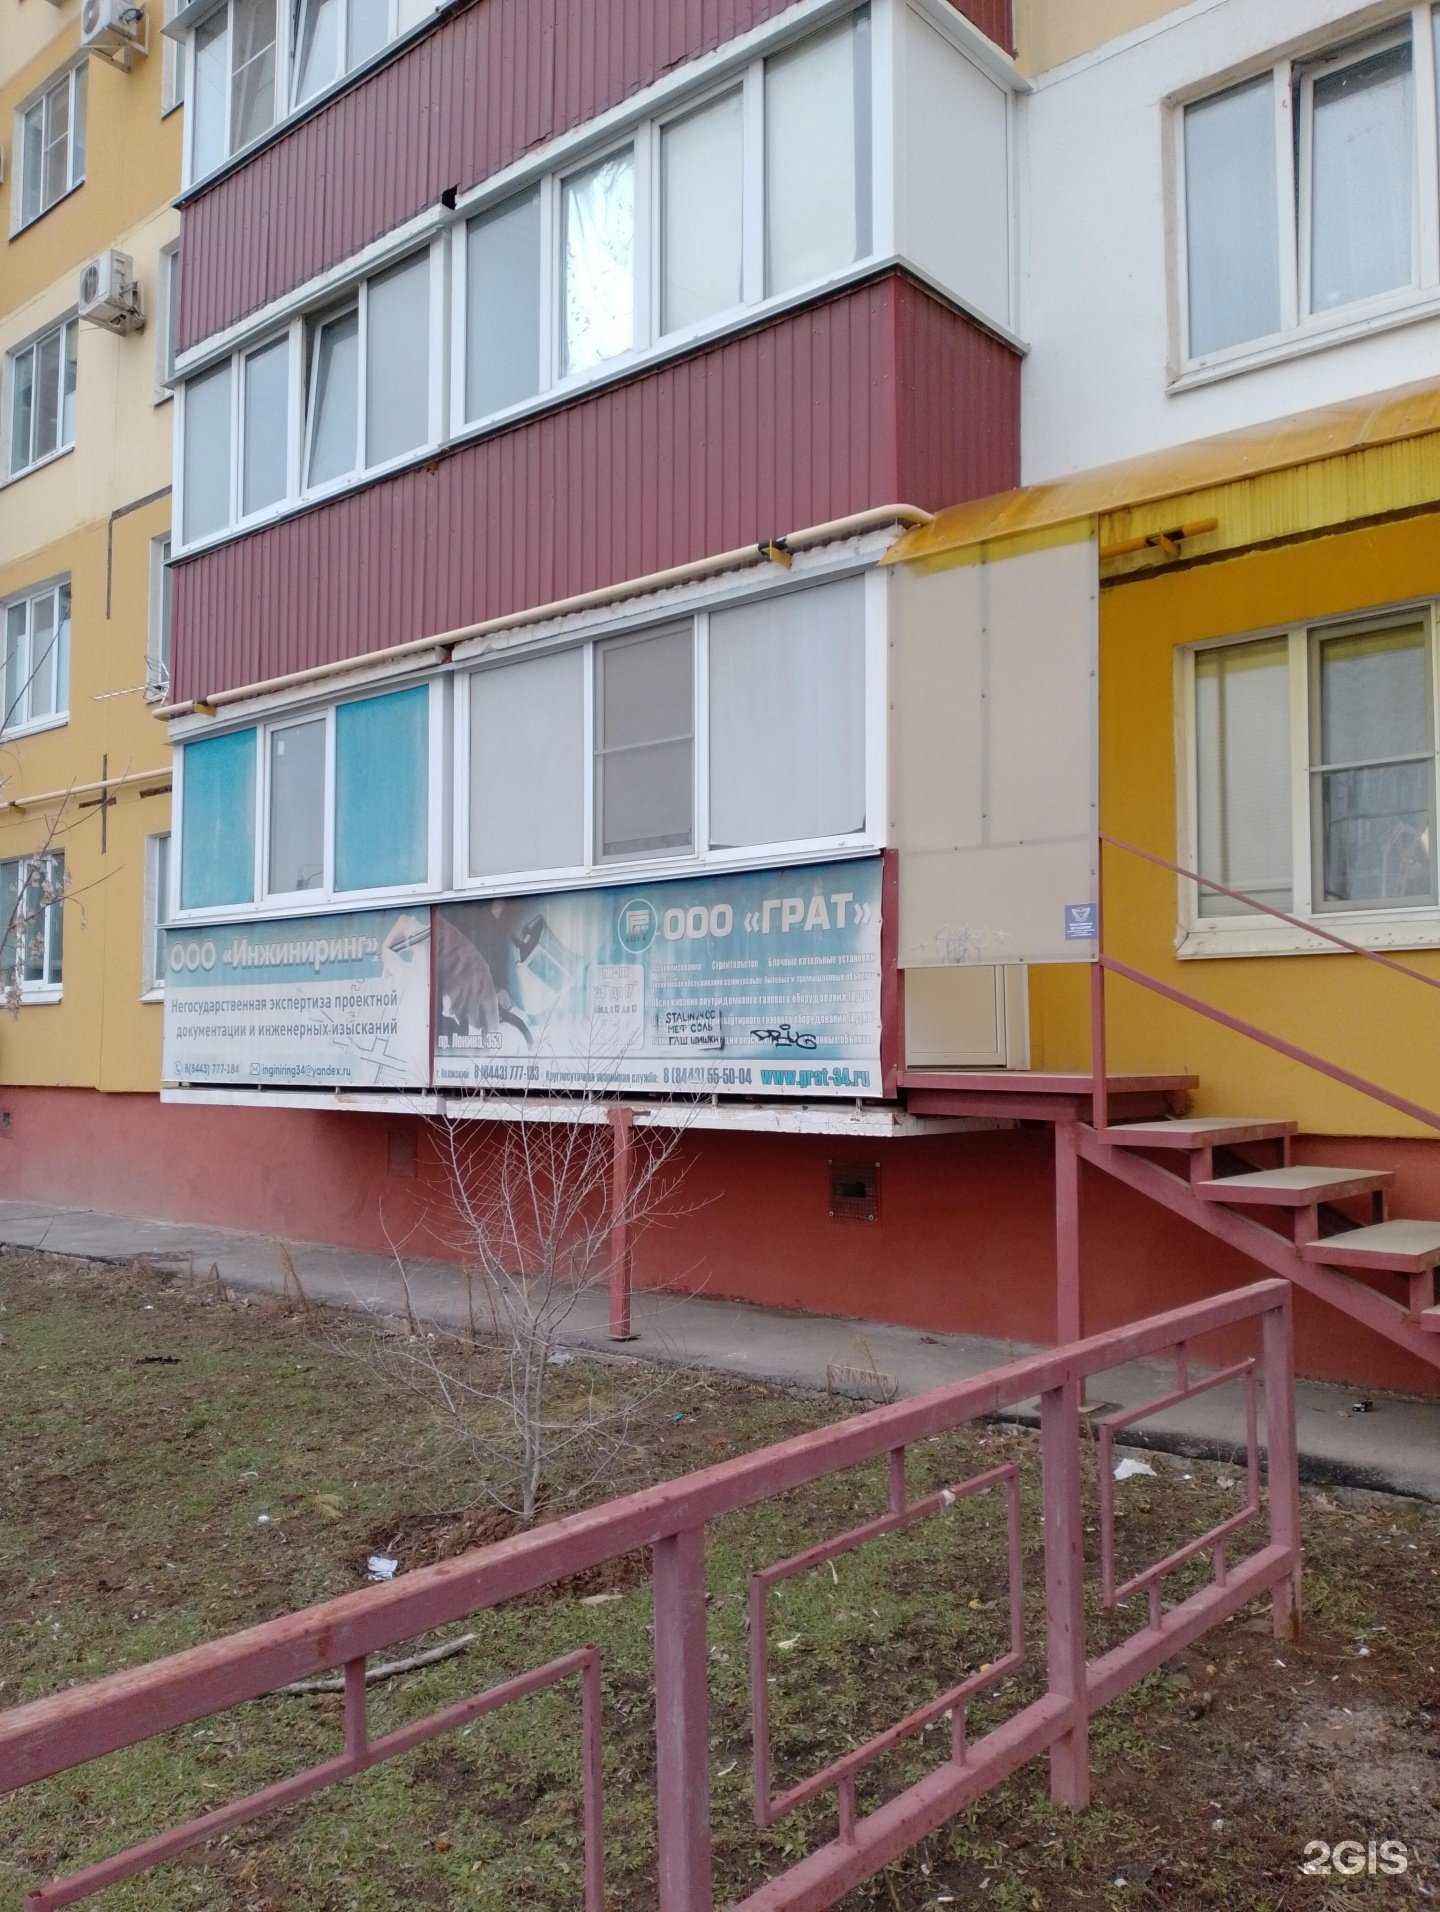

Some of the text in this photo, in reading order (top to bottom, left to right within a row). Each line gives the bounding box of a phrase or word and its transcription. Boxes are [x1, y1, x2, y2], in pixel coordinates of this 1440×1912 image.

[664, 892, 871, 940] ООО «ГРАТ»
[171, 935, 380, 973] ООО «Инжиниринг»
[172, 990, 399, 1016] Негосударственная экспертиза проектной
[176, 1019, 399, 1041] документации и инженерных изысканий
[706, 1067, 752, 1086] 55-50-04
[760, 1067, 871, 1089] www.grat-34.ru
